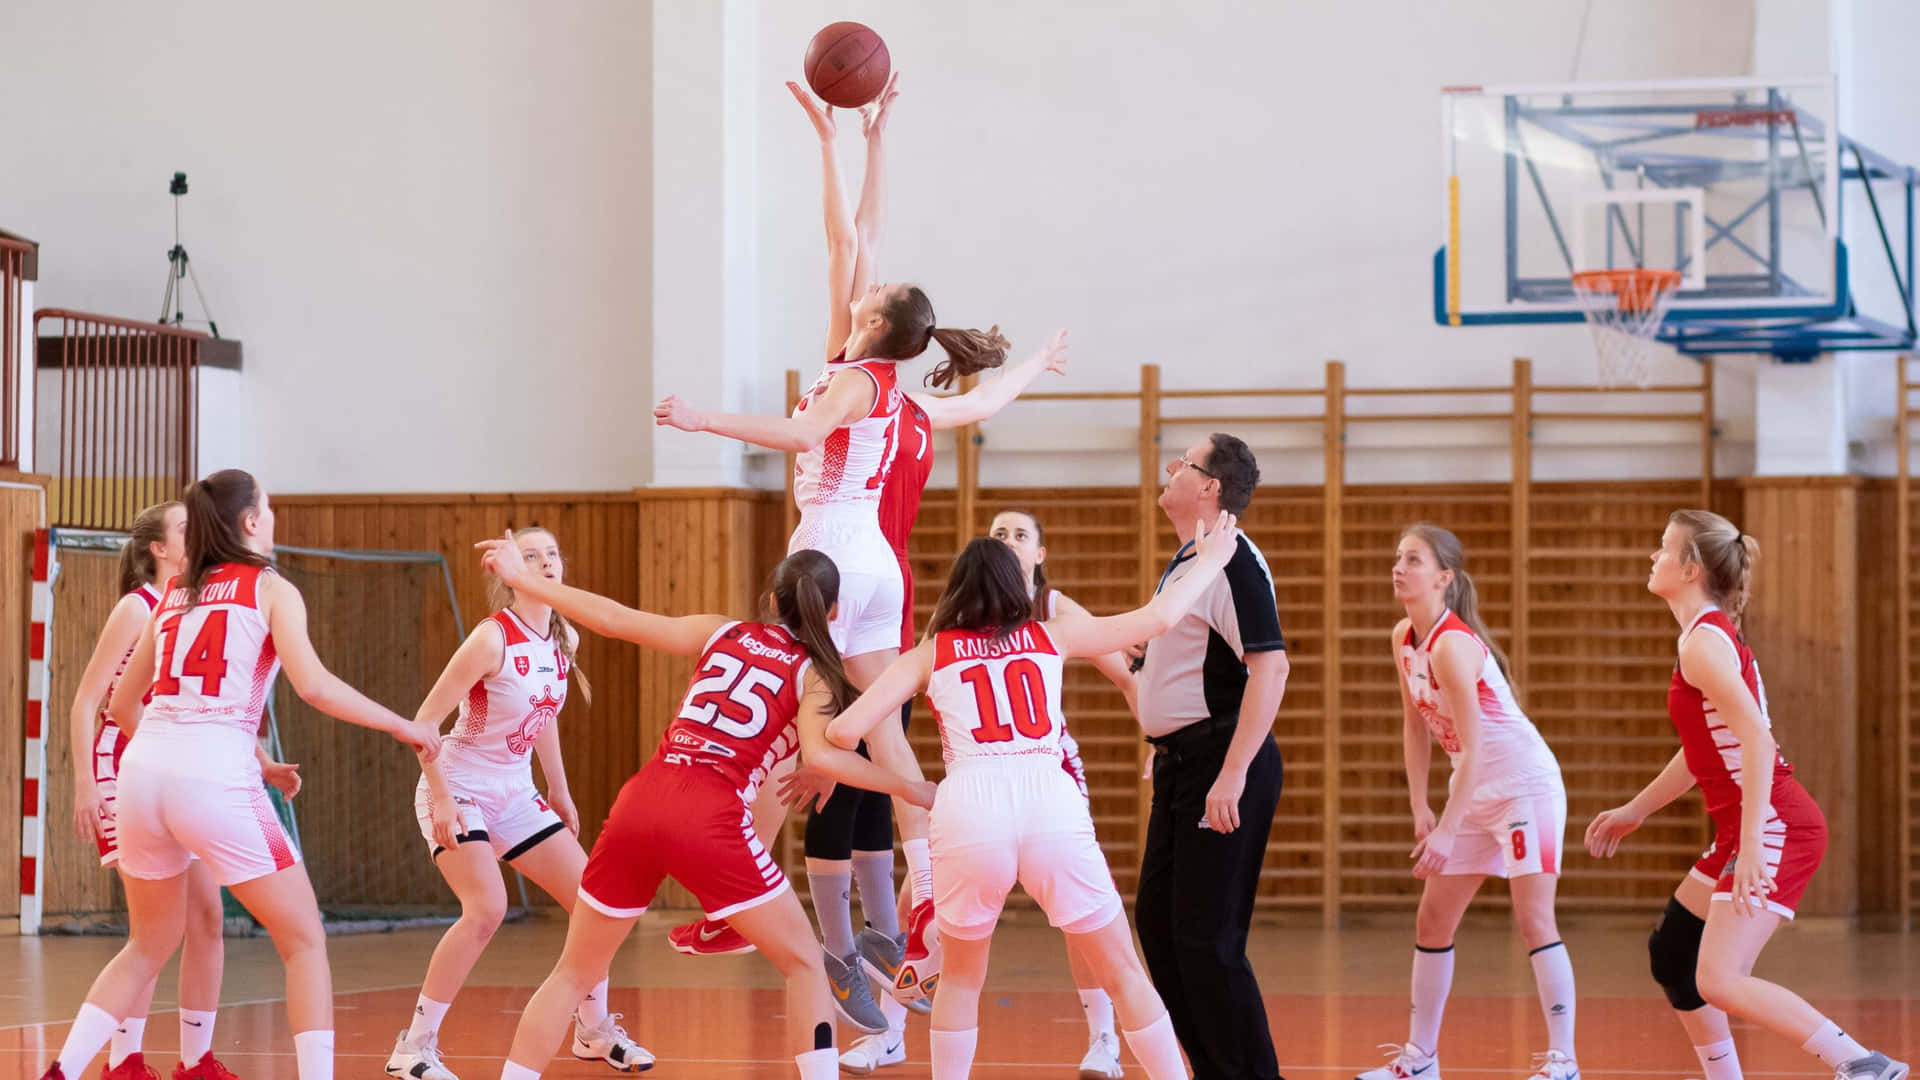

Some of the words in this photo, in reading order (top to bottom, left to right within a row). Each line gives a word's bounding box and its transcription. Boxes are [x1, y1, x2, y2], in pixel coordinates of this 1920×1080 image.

[152, 609, 229, 697] 14
[737, 632, 799, 664] legrand
[678, 651, 786, 740] 25
[960, 658, 1052, 744] 10
[1511, 829, 1527, 861] 8
